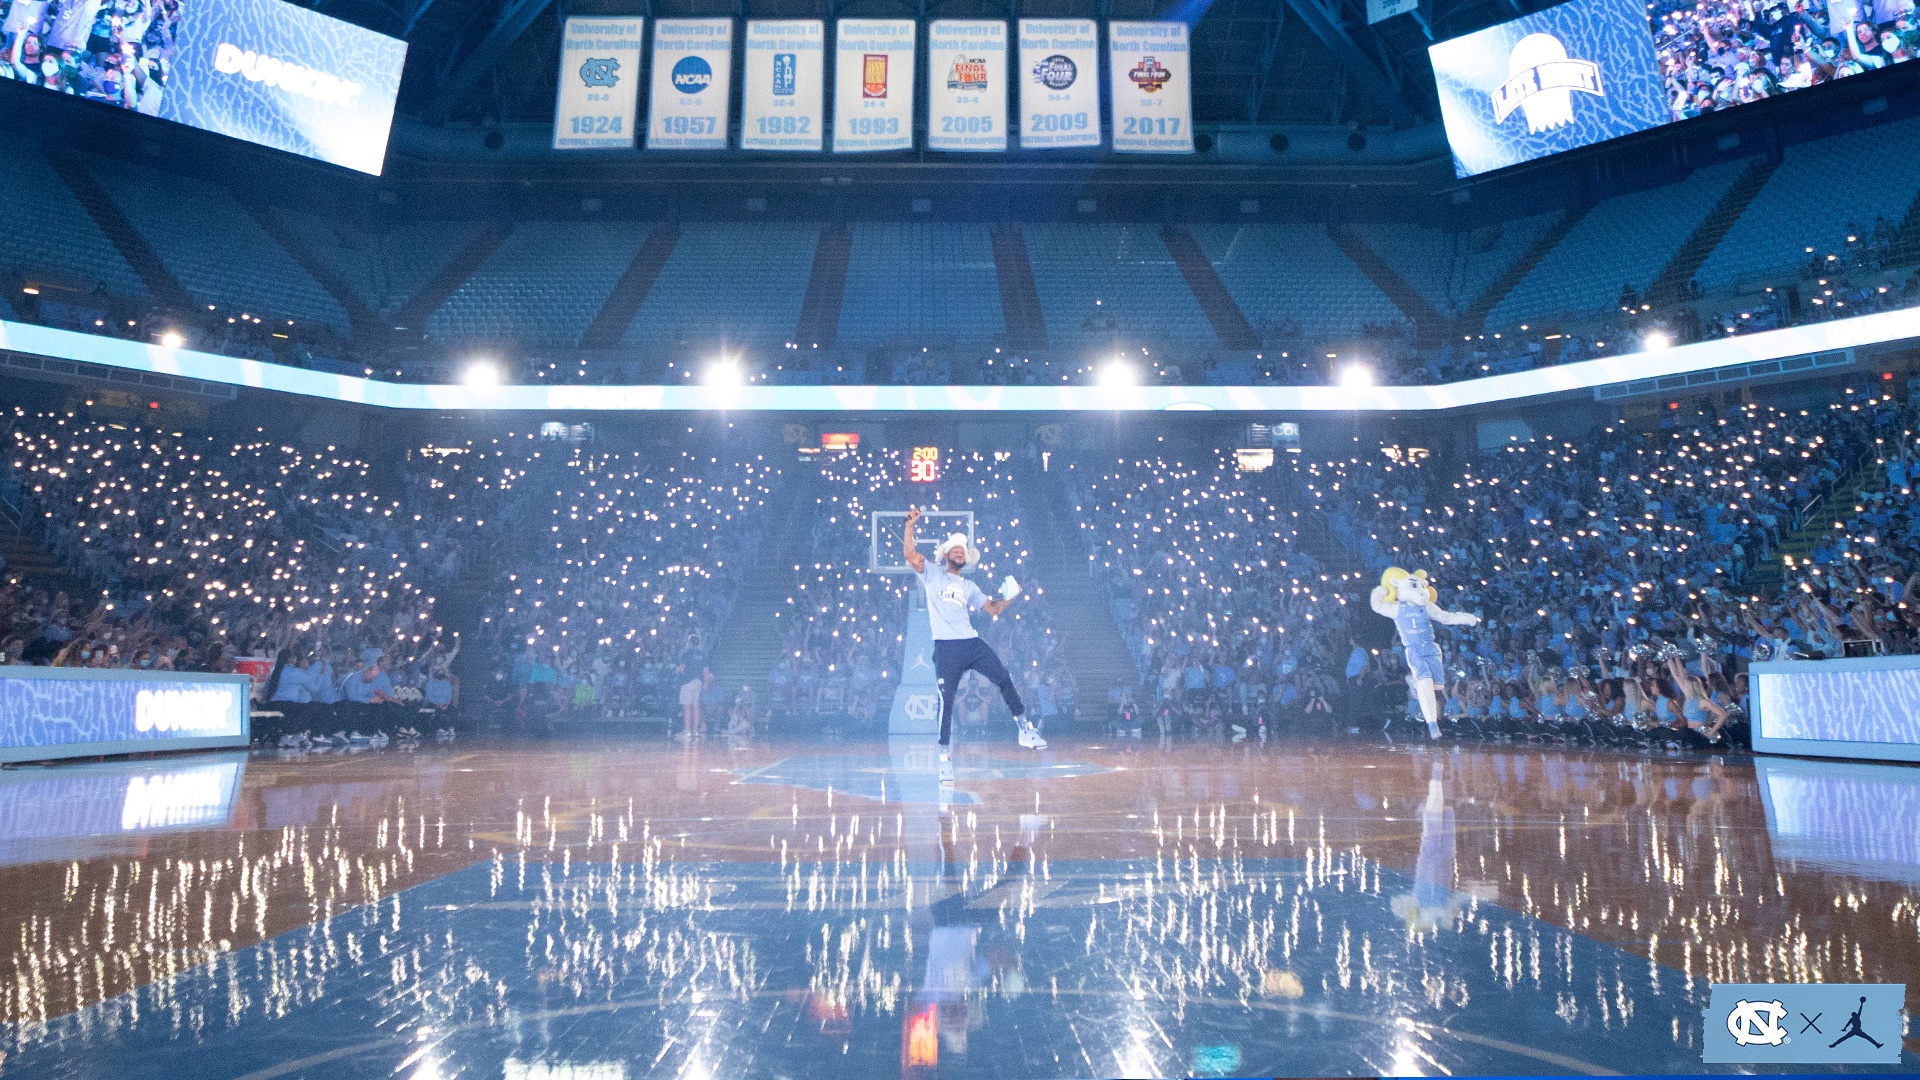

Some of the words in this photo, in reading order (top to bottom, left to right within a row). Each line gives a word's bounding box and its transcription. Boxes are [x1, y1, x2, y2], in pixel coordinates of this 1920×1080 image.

[571, 23, 624, 35] University
[626, 23, 637, 35] of
[661, 23, 715, 35] University
[716, 24, 727, 35] of
[753, 24, 807, 35] University
[808, 24, 819, 35] of
[844, 24, 897, 36] University
[899, 24, 909, 36] of
[936, 24, 988, 36] University
[990, 24, 1001, 36] of
[1025, 23, 1078, 35] University
[1080, 23, 1090, 35] of
[1117, 26, 1169, 37] University
[1170, 25, 1181, 36] of
[566, 39, 593, 50] North
[597, 39, 640, 50] Carolina
[656, 39, 684, 50] North
[686, 39, 731, 50] Carolina
[748, 39, 776, 50] North
[779, 39, 823, 50] Carolina
[839, 40, 867, 51] North
[870, 40, 913, 51] Carolina
[931, 39, 959, 50] North
[961, 39, 1005, 50] Carolina
[1021, 38, 1049, 49] North
[1052, 38, 1095, 49] Carolina
[1112, 41, 1140, 52] North
[1142, 41, 1186, 52] Carolina
[955, 64, 986, 73] FINAL
[1049, 62, 1073, 71] FINAL
[674, 74, 712, 85] NCAA
[959, 73, 986, 82] FOUR
[1041, 68, 1073, 81] FOUR
[571, 116, 623, 134] 1924
[662, 116, 717, 134] 1957
[757, 116, 811, 134] 1982
[849, 117, 899, 135] 1993
[942, 116, 993, 133] 2005
[1031, 112, 1088, 132] 2009
[1124, 117, 1180, 135] 2017
[913, 447, 938, 460] 2:00
[911, 460, 935, 481] 30
[1411, 618, 1417, 628] 1
